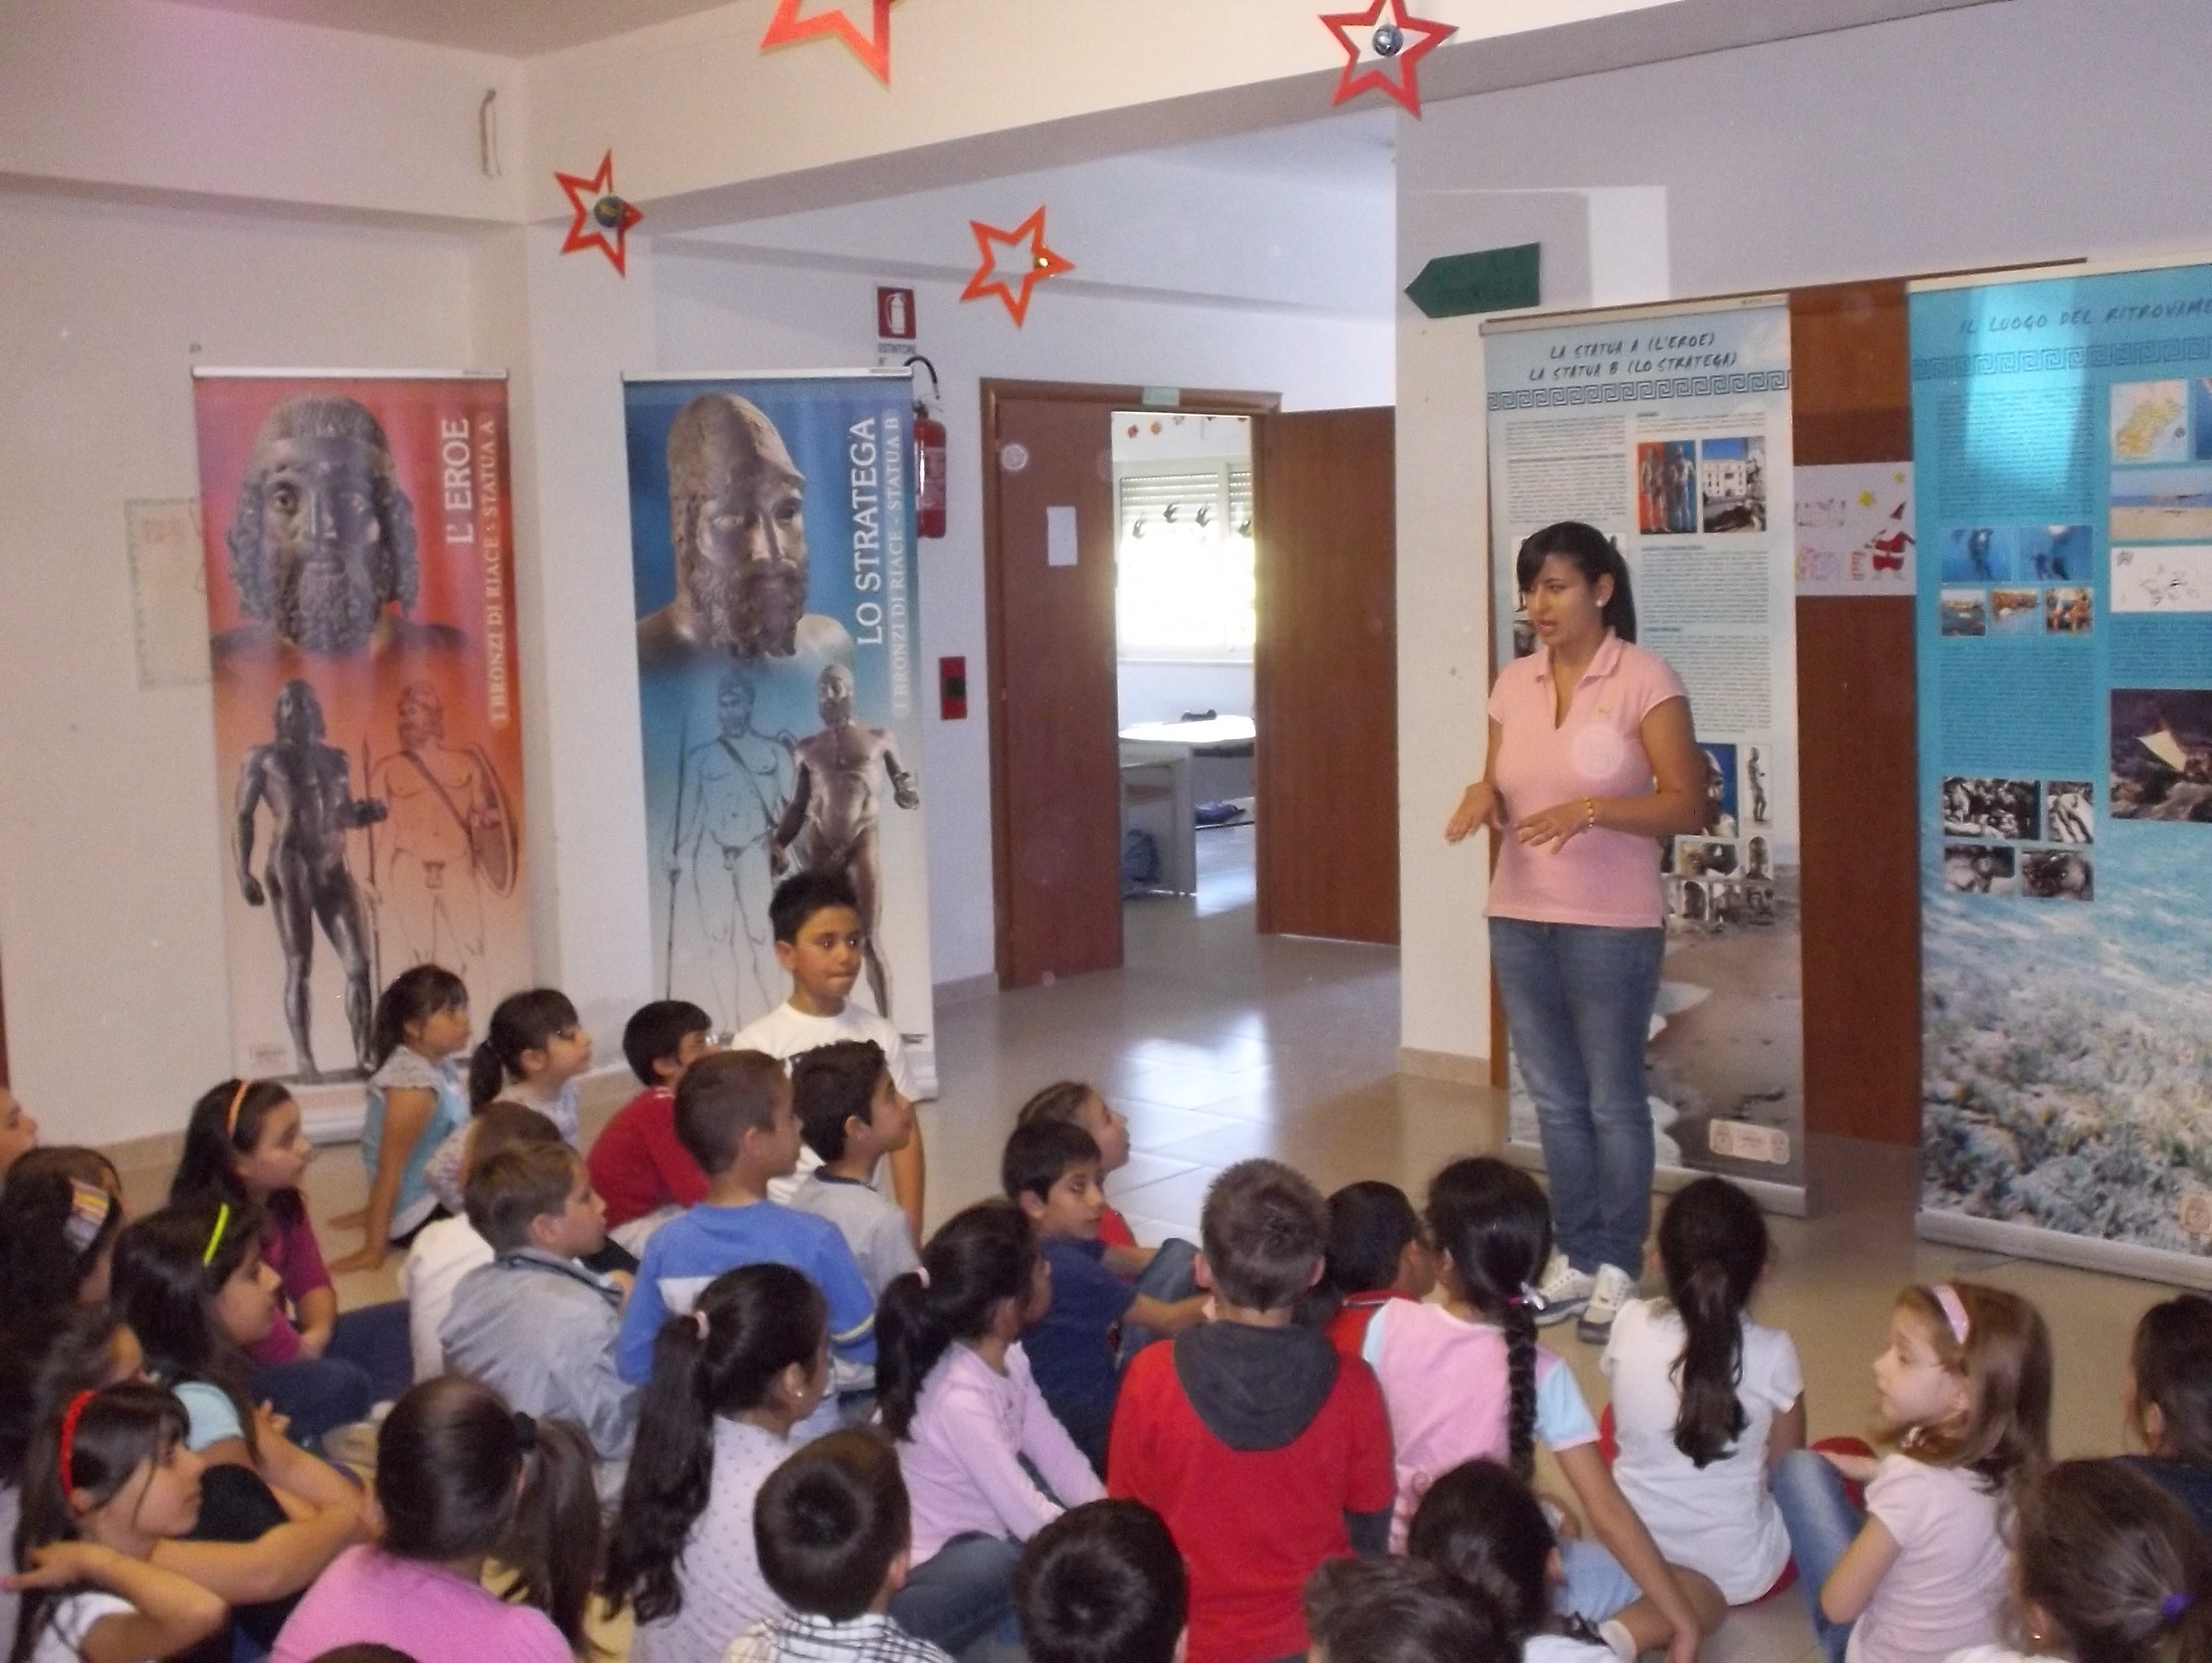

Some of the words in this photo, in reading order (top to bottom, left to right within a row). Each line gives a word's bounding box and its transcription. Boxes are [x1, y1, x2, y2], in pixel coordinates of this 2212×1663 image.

[1989, 314, 2048, 332] LUOGO
[2060, 309, 2092, 326] DEL
[1550, 345, 1566, 359] LA
[1575, 339, 1623, 358] STATUA
[1630, 338, 1639, 353] A
[1648, 332, 1715, 351] (L'EROE)
[1529, 367, 1545, 381] LA
[1553, 362, 1601, 380] STATUA
[1610, 360, 1619, 374] B
[1627, 359, 1652, 374] (LO
[1657, 351, 1737, 372] STRATEGA)
[479, 420, 495, 434] A
[884, 417, 899, 429] B
[442, 418, 473, 510] EROE
[481, 439, 496, 517] STATUA
[885, 435, 902, 510] STATUA
[849, 417, 882, 593] STRATEGA
[888, 530, 904, 589] RIACE
[486, 605, 503, 625] DI
[855, 602, 882, 646] LO
[890, 597, 905, 616] DI
[891, 624, 907, 695] BRONZI
